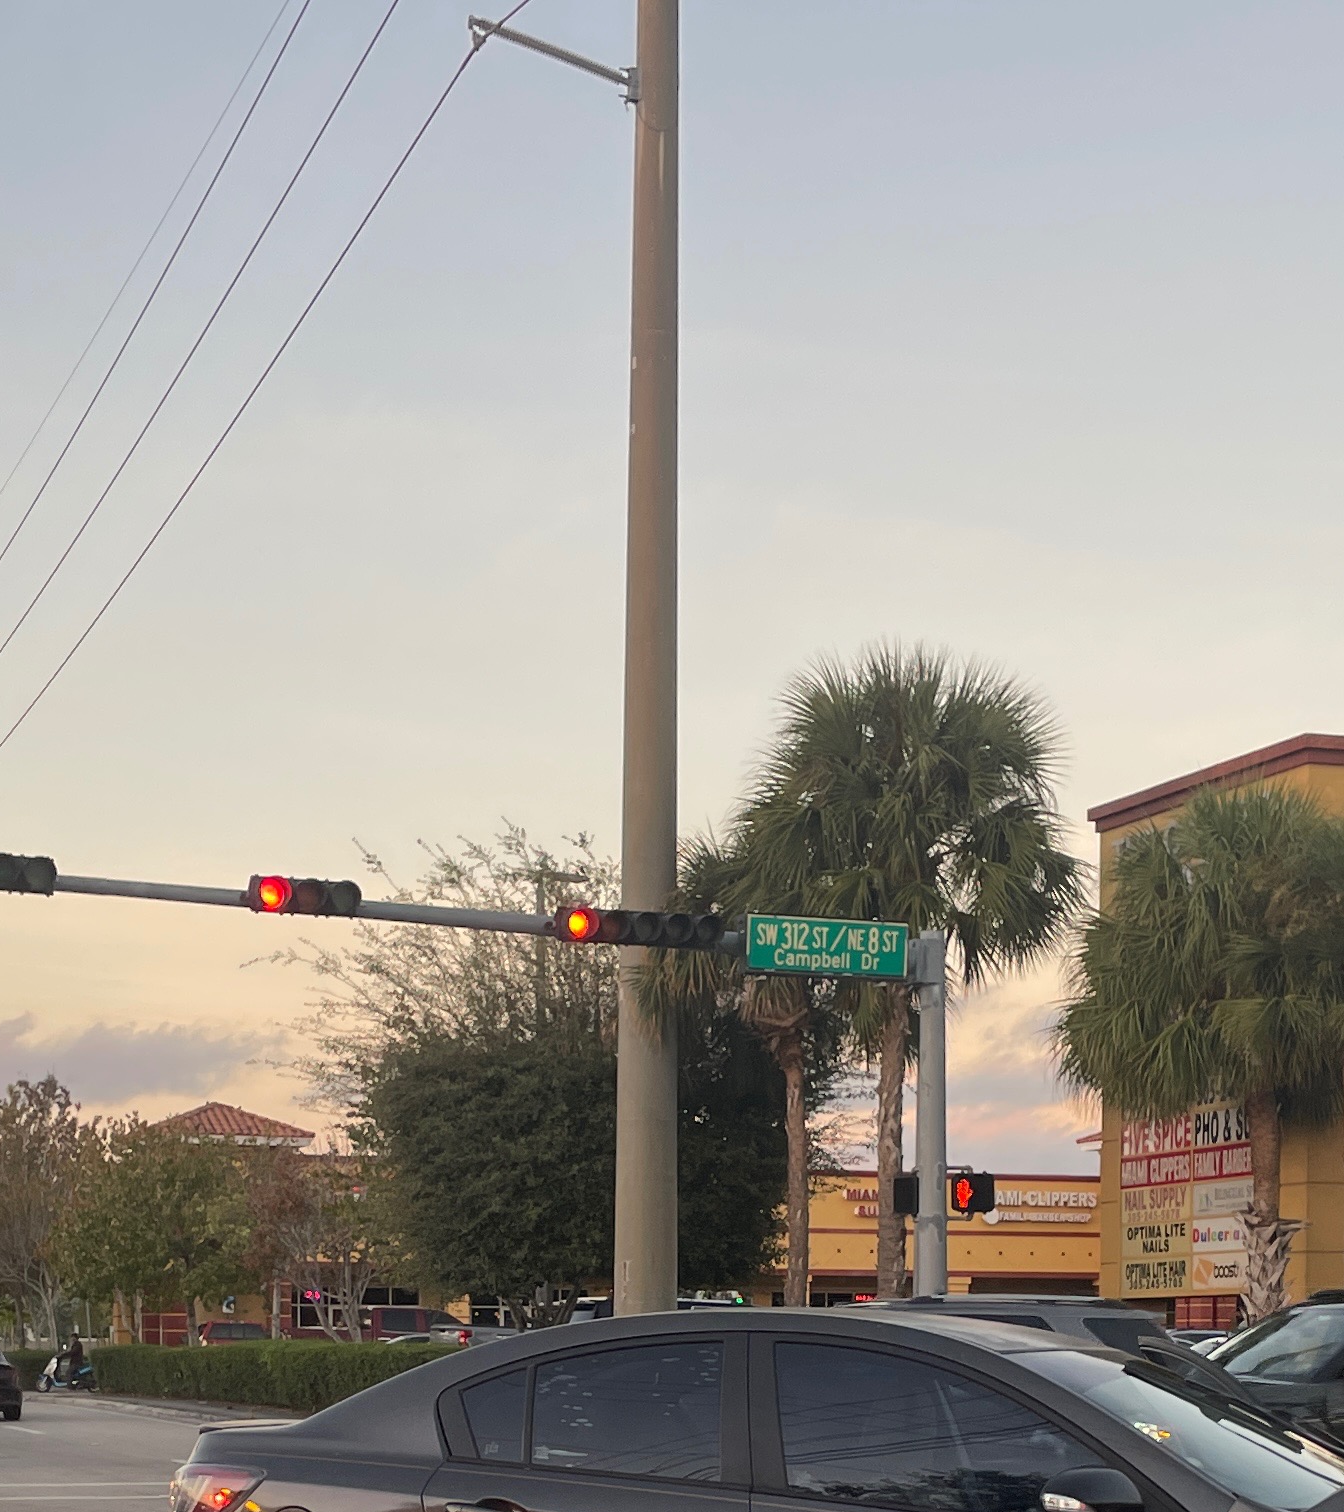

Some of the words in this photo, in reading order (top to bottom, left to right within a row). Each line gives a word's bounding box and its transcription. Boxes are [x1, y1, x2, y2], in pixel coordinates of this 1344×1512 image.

[756, 922, 777, 946] SW
[781, 921, 810, 951] 312
[812, 926, 829, 950] ST
[847, 928, 865, 951] NE
[868, 927, 880, 955] 8
[882, 930, 899, 953] ST
[773, 948, 851, 971] Campbell
[861, 953, 880, 971] Dr
[1153, 1113, 1191, 1153] SPICE
[1194, 1110, 1219, 1147] PHO
[1223, 1108, 1232, 1142] &
[1026, 1190, 1098, 1208] CLIPPERS
[1124, 1190, 1147, 1212] NAIL
[1149, 1186, 1187, 1210] SUPPLY
[1127, 1224, 1161, 1240] OPTIMA
[1164, 1222, 1186, 1238] LITE
[1192, 1226, 1240, 1243] Dulcera
[1142, 1239, 1170, 1254] NAILS
